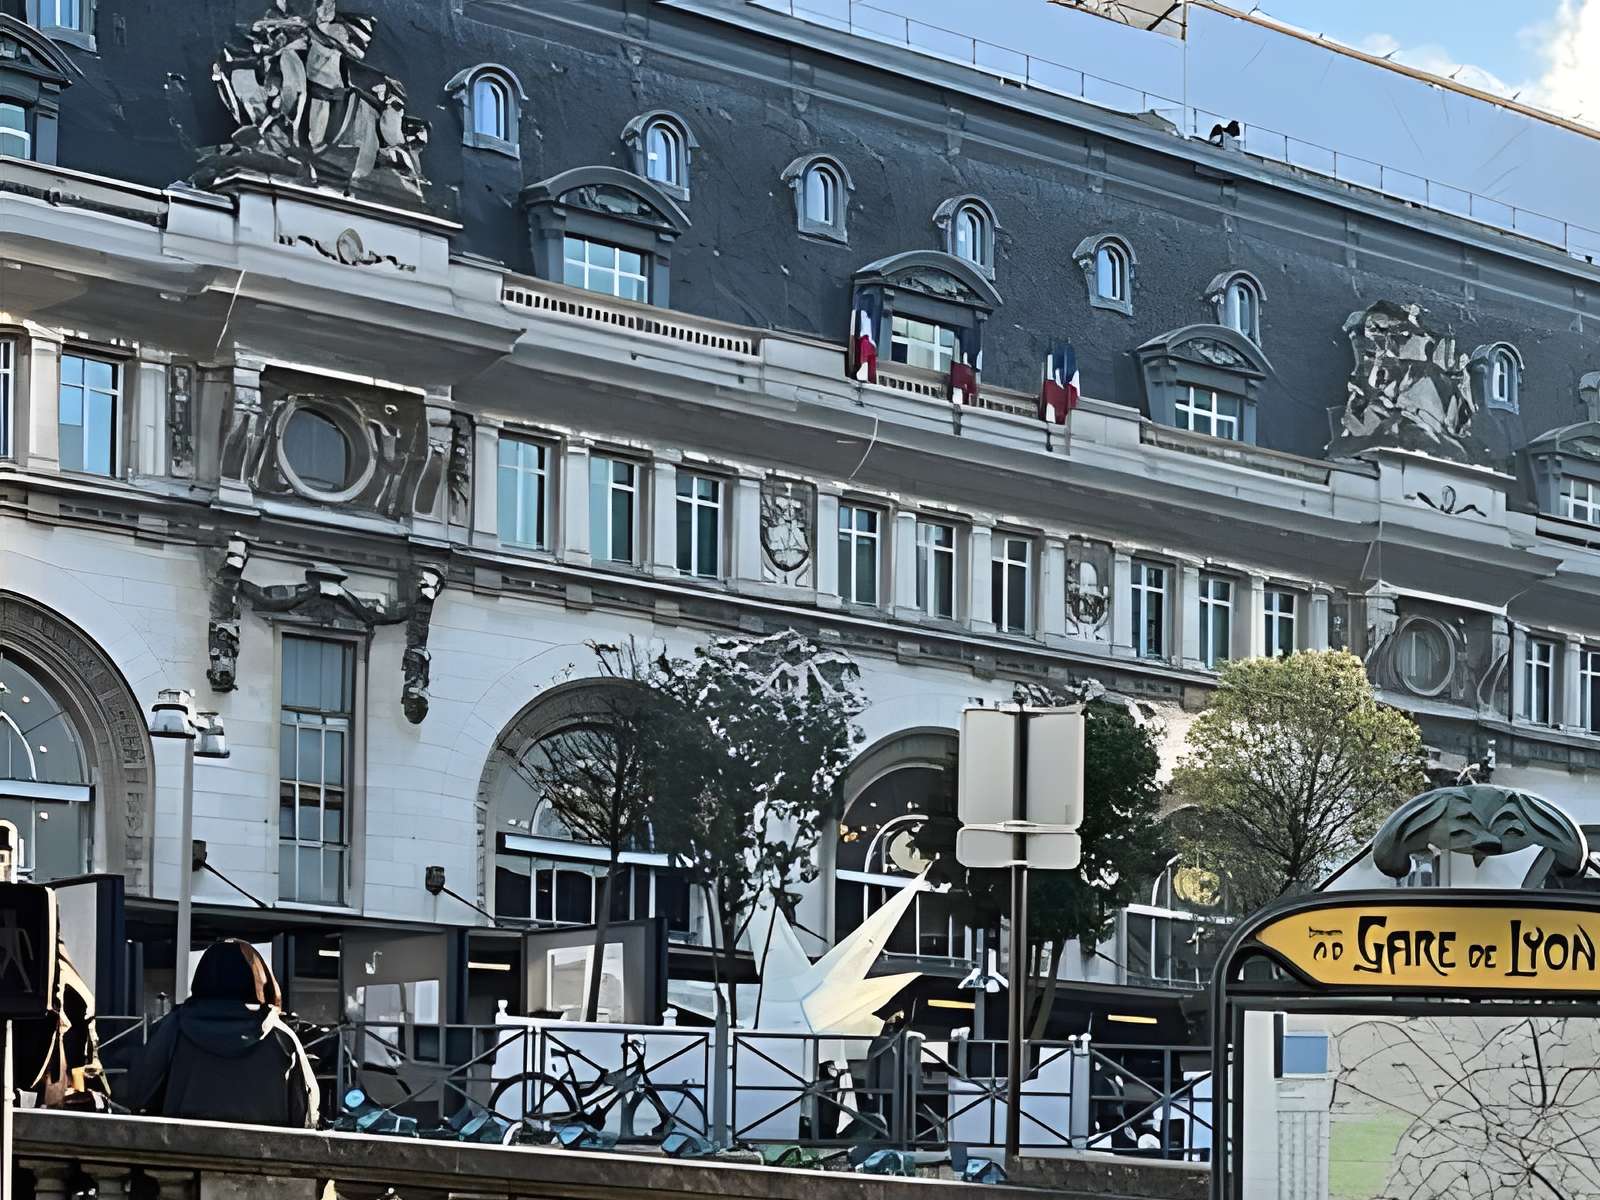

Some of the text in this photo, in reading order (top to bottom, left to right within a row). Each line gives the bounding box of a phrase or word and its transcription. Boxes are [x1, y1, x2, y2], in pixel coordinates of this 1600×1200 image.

[1353, 915, 1457, 976] GARE
[1468, 944, 1497, 968] DE
[1504, 919, 1596, 977] LYON
